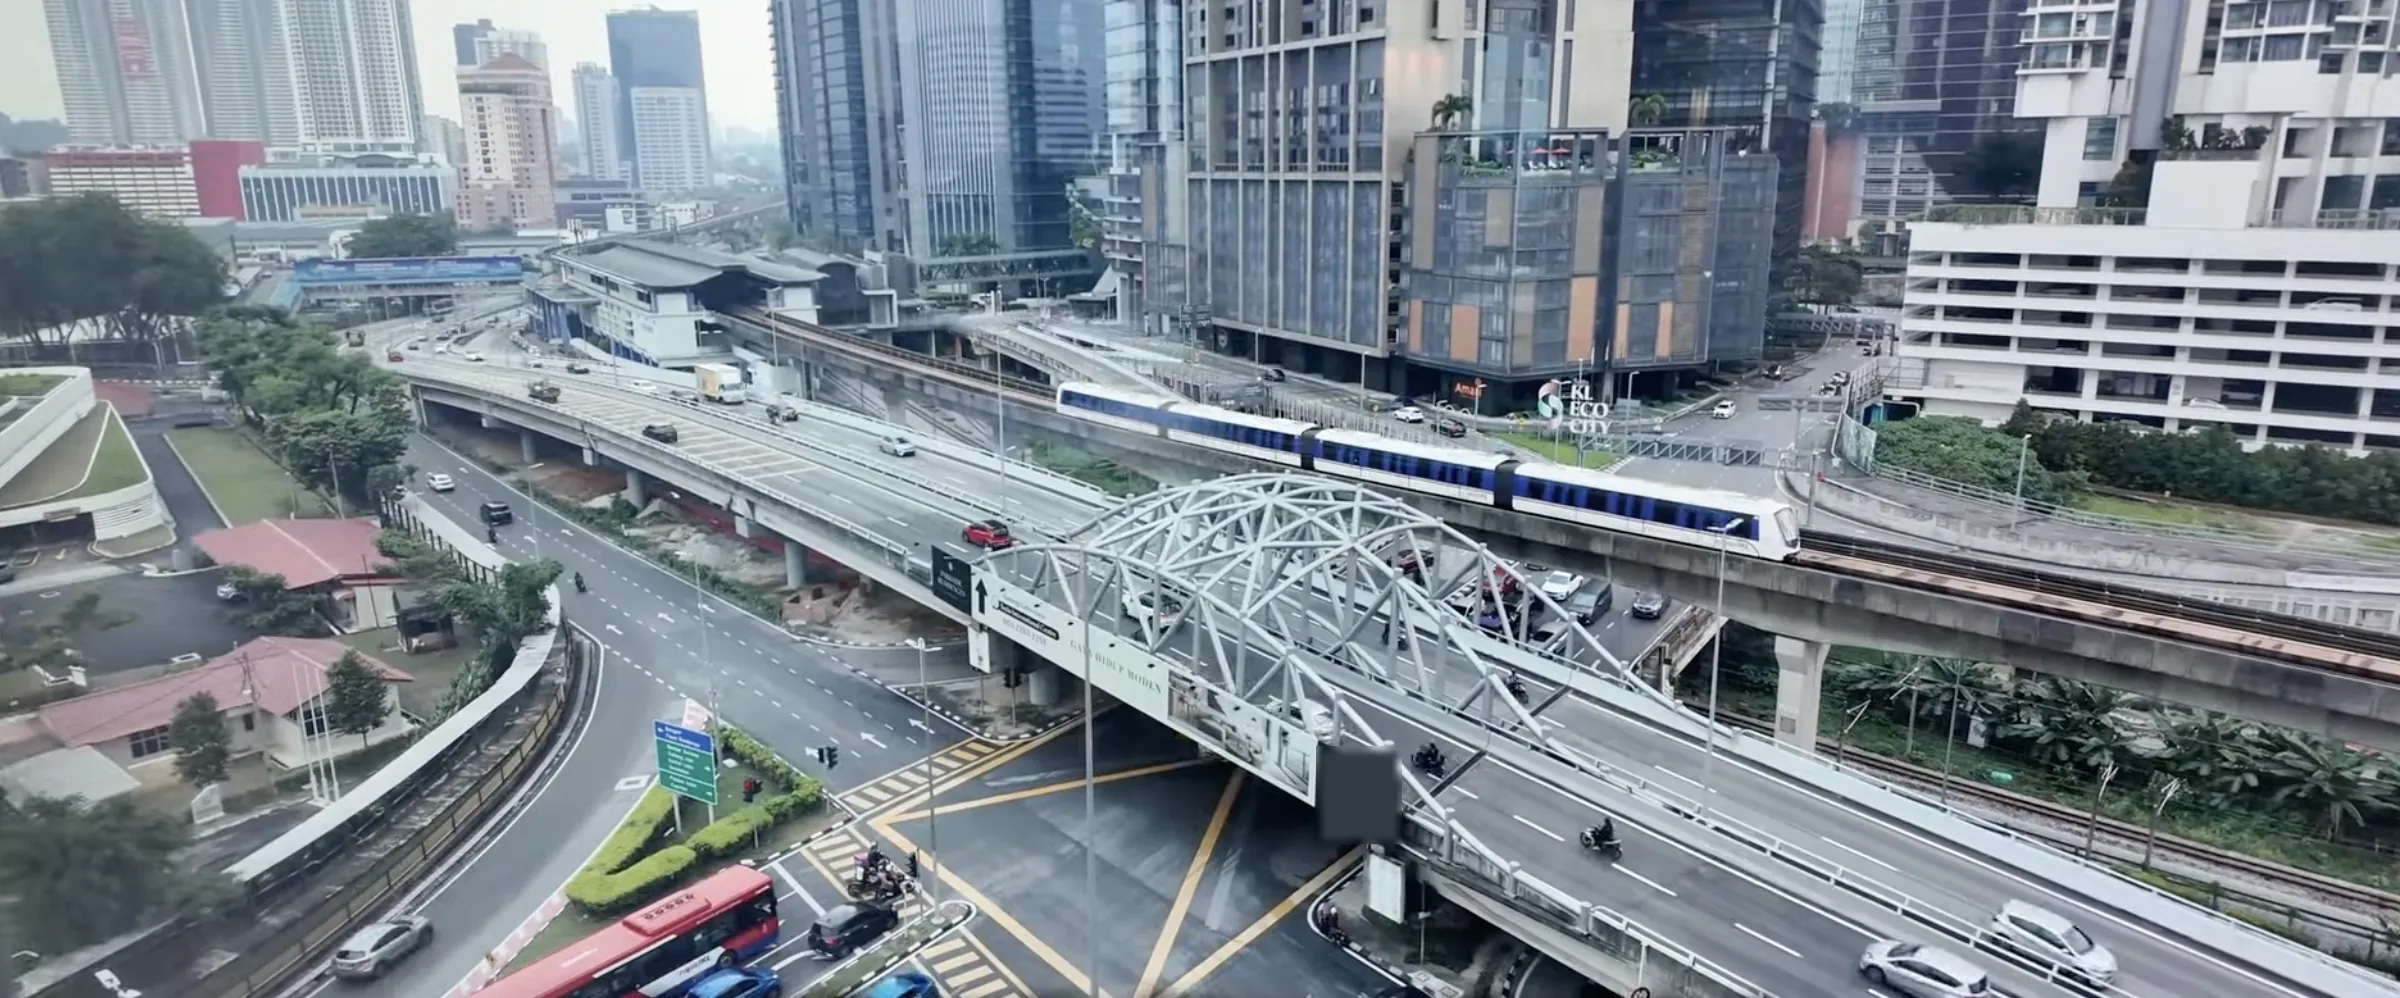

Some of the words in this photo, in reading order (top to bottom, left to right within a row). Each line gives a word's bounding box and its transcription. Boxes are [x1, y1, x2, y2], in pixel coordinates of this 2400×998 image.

[1454, 377, 1482, 397] Amai
[1571, 384, 1594, 400] KL
[1570, 401, 1609, 419] ECO
[1570, 420, 1613, 434] CITY
